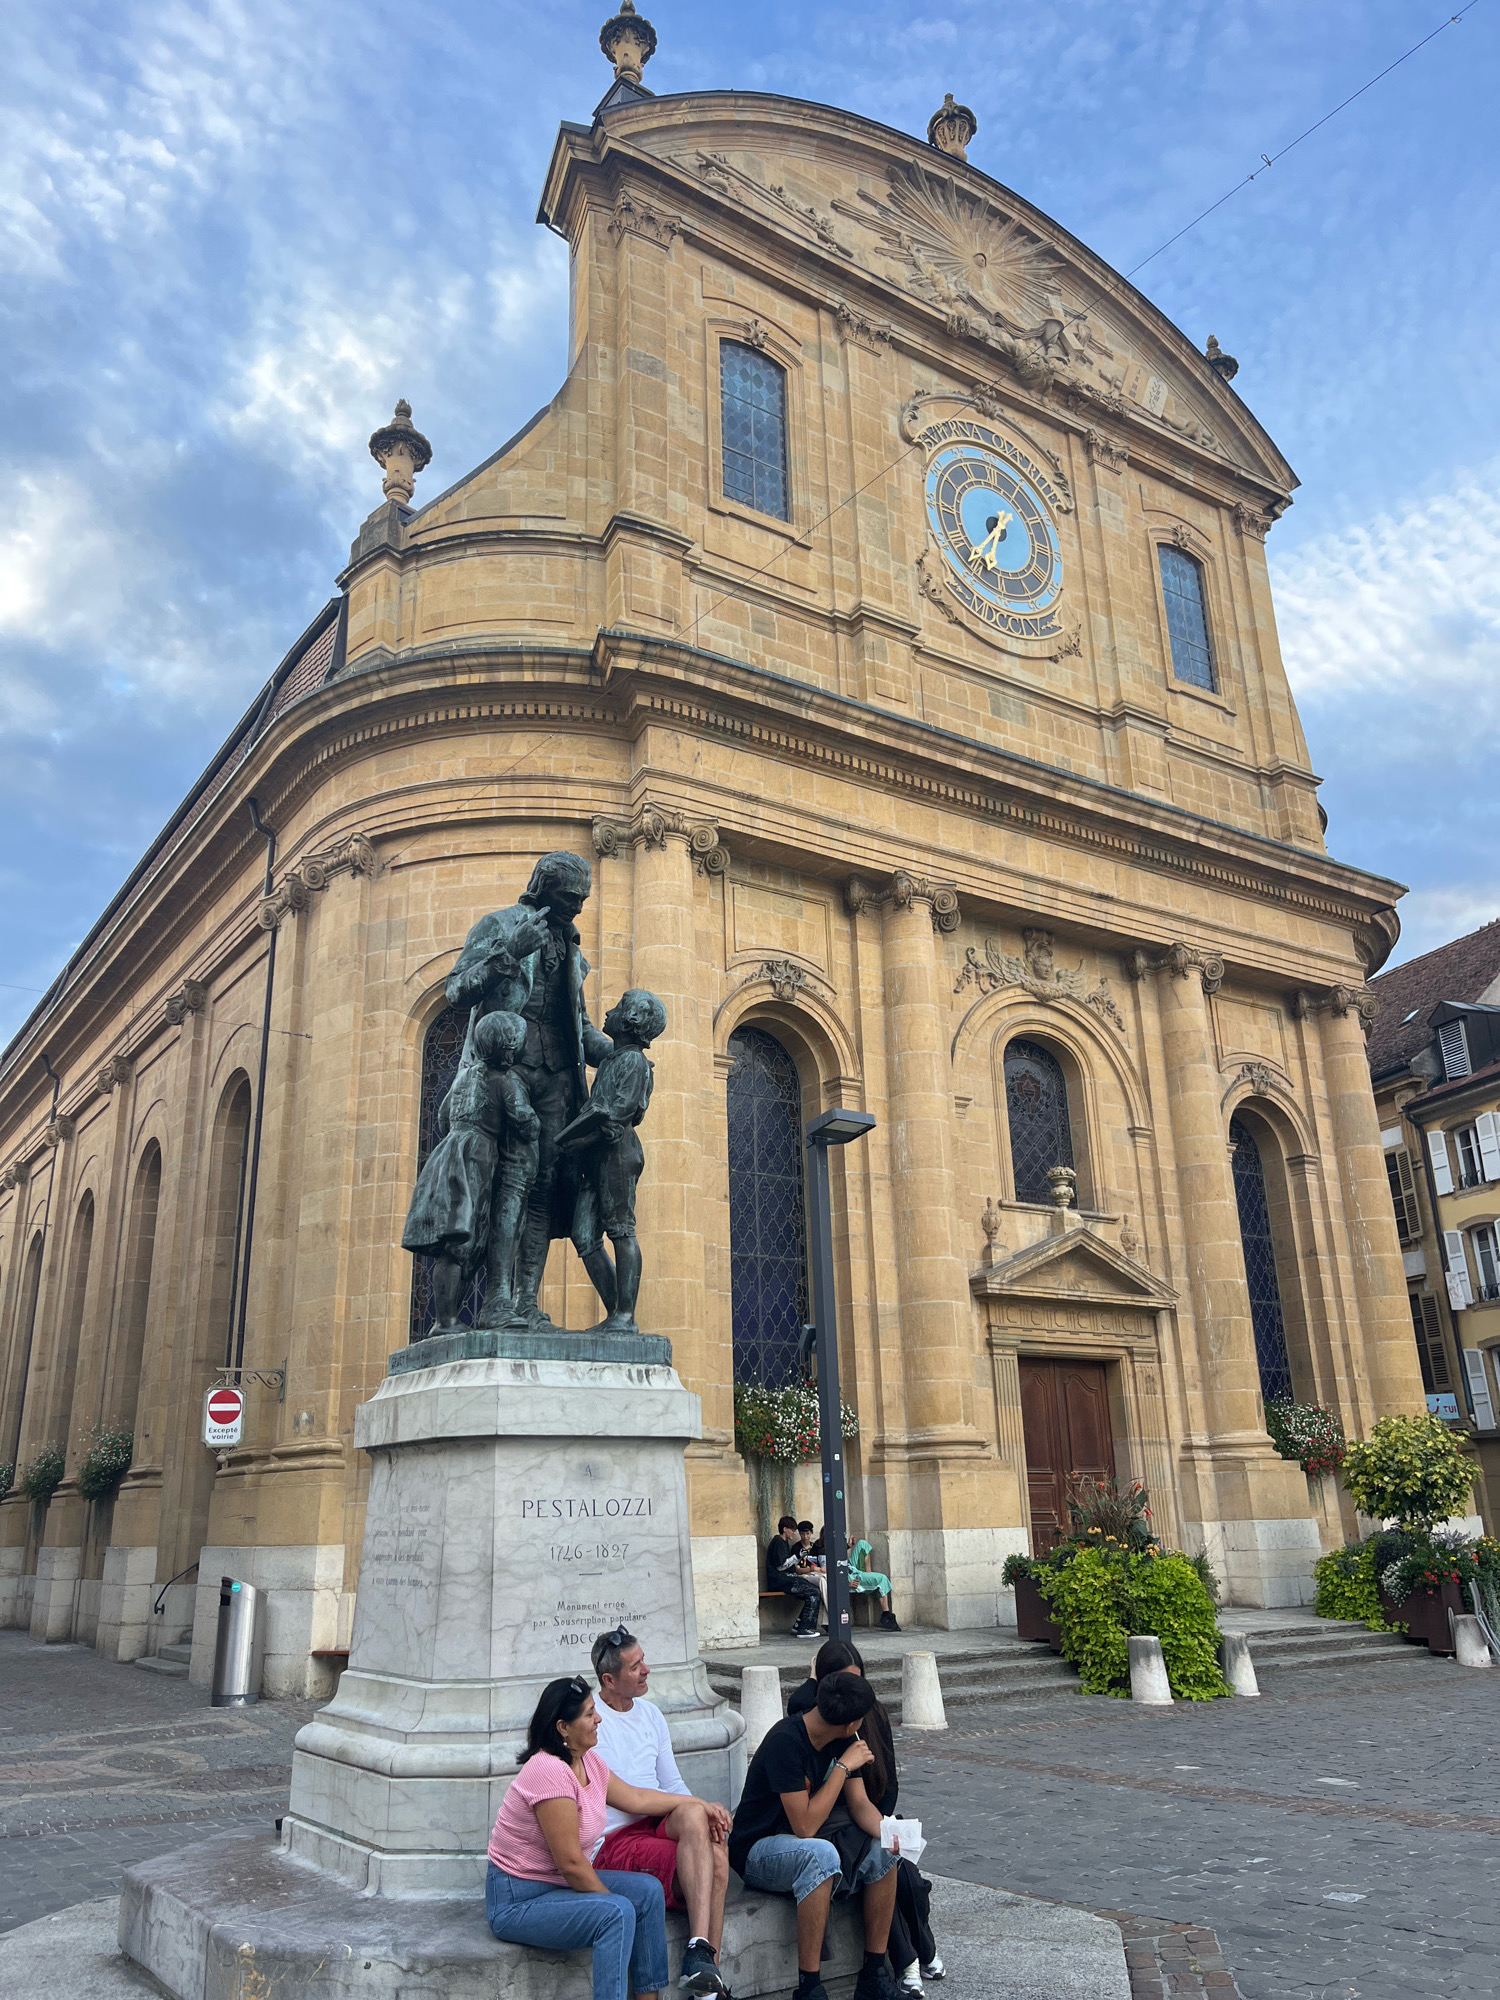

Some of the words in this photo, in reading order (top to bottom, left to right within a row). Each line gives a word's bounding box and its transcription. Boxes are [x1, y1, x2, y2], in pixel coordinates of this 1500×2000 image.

[1443, 1405, 1457, 1413] TUI
[522, 1498, 652, 1518] PESTALOZZI
[557, 1601, 600, 1612] Monument
[533, 1620, 547, 1631] par
[553, 1616, 606, 1628] Souscription
[610, 1613, 646, 1627] populaire
